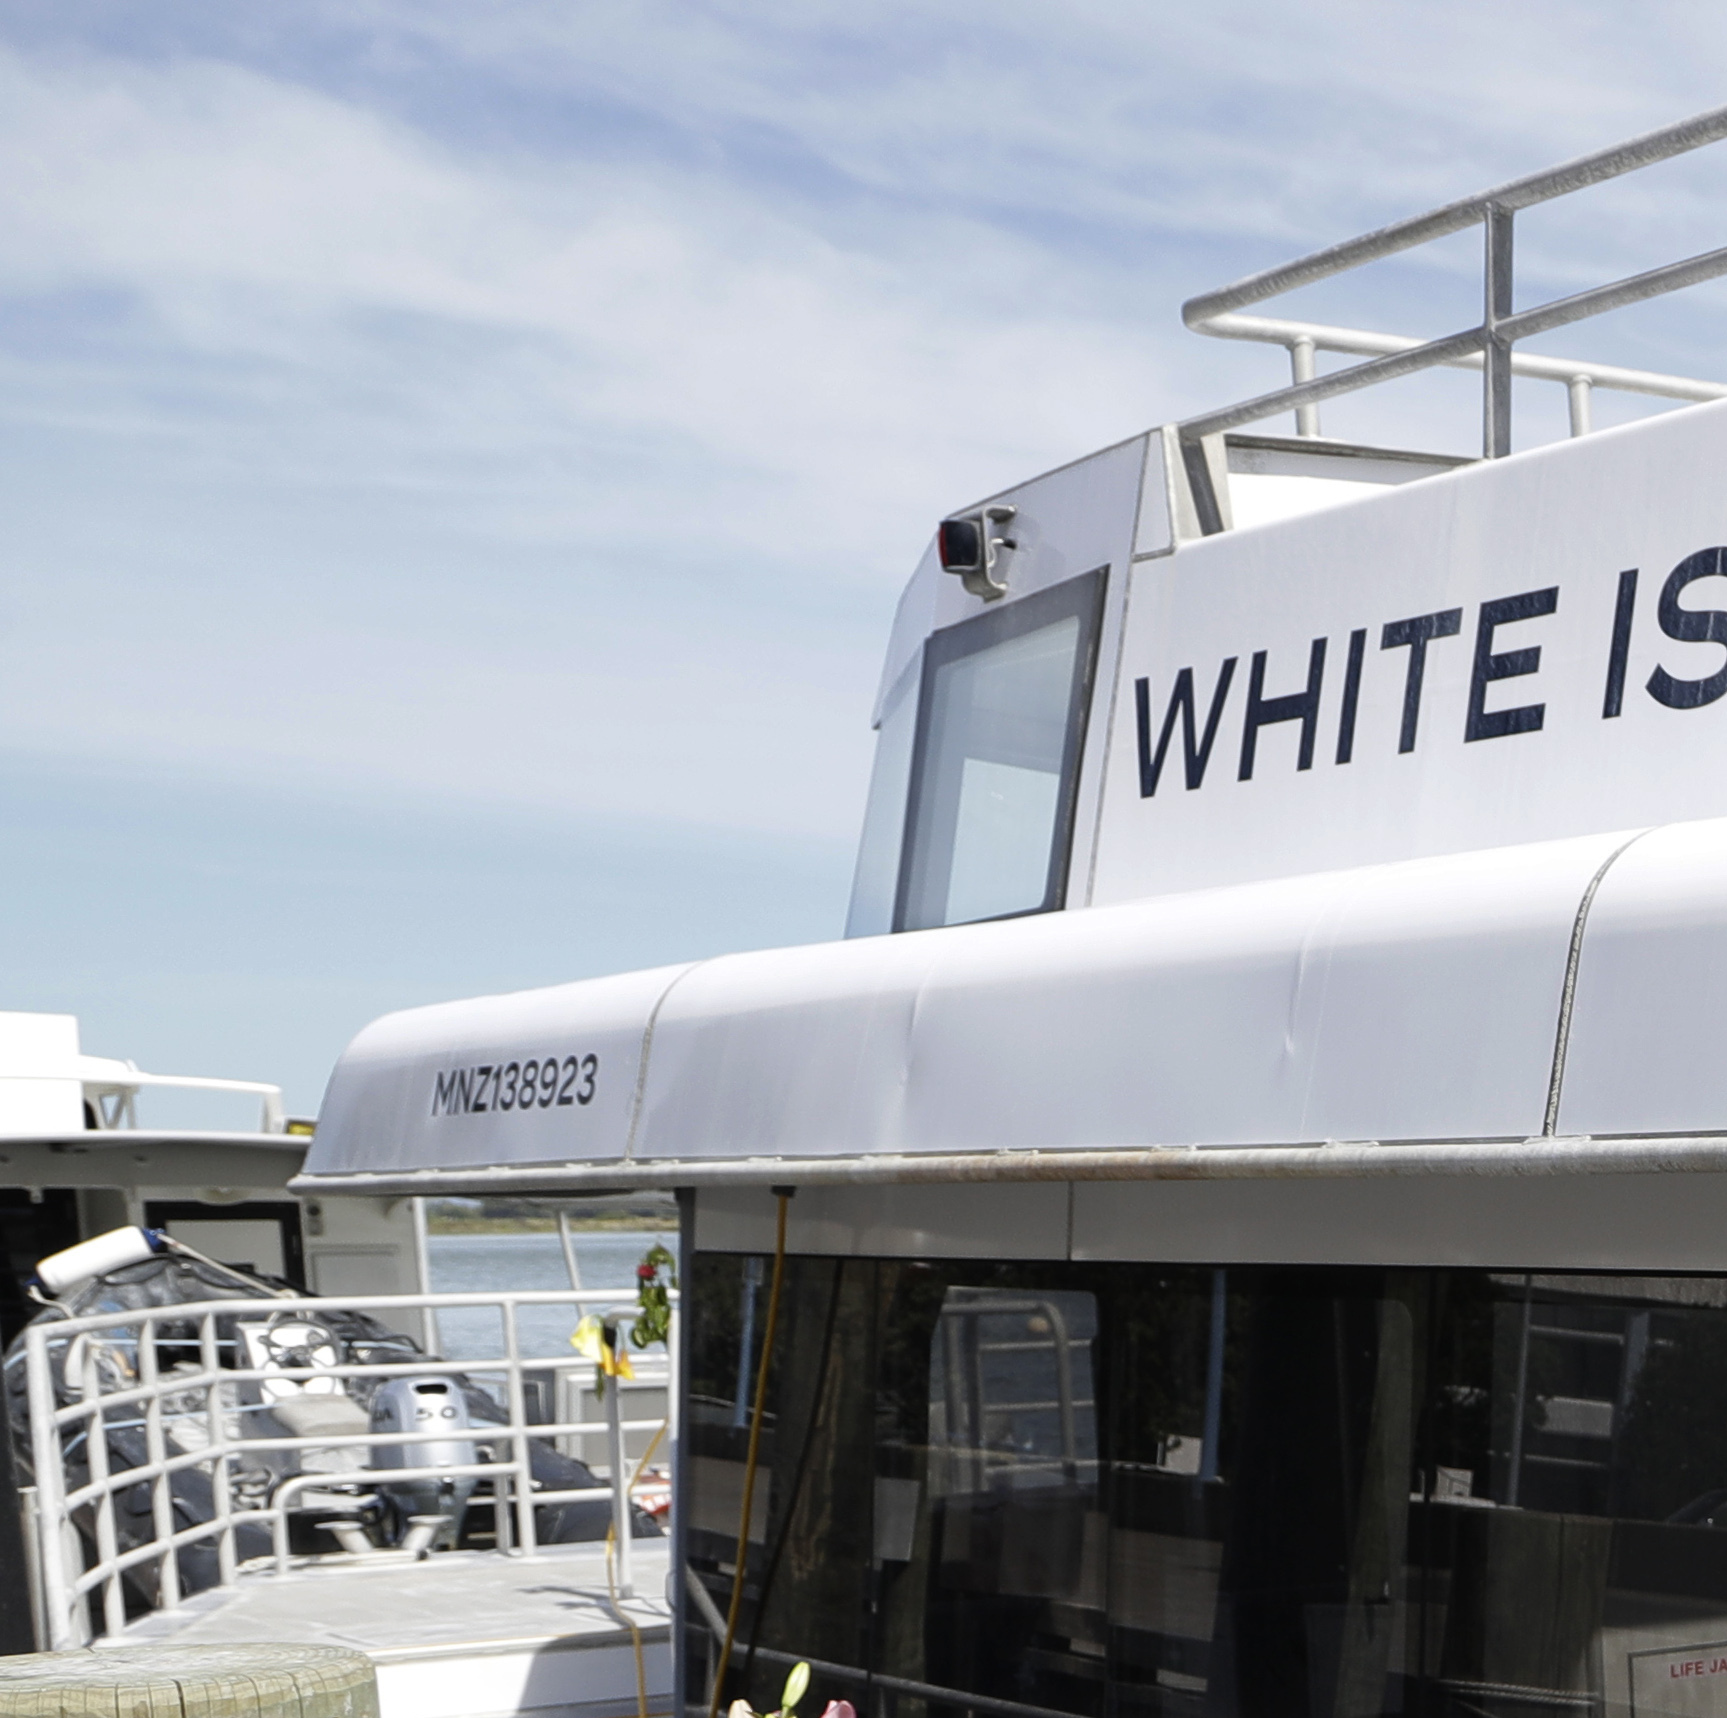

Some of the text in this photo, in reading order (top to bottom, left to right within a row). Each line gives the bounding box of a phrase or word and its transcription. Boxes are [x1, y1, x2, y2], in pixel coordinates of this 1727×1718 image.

[1134, 585, 1560, 799] WHITE
[430, 1053, 599, 1117] MNZ138923
[1669, 1660, 1704, 1679] LIFE
